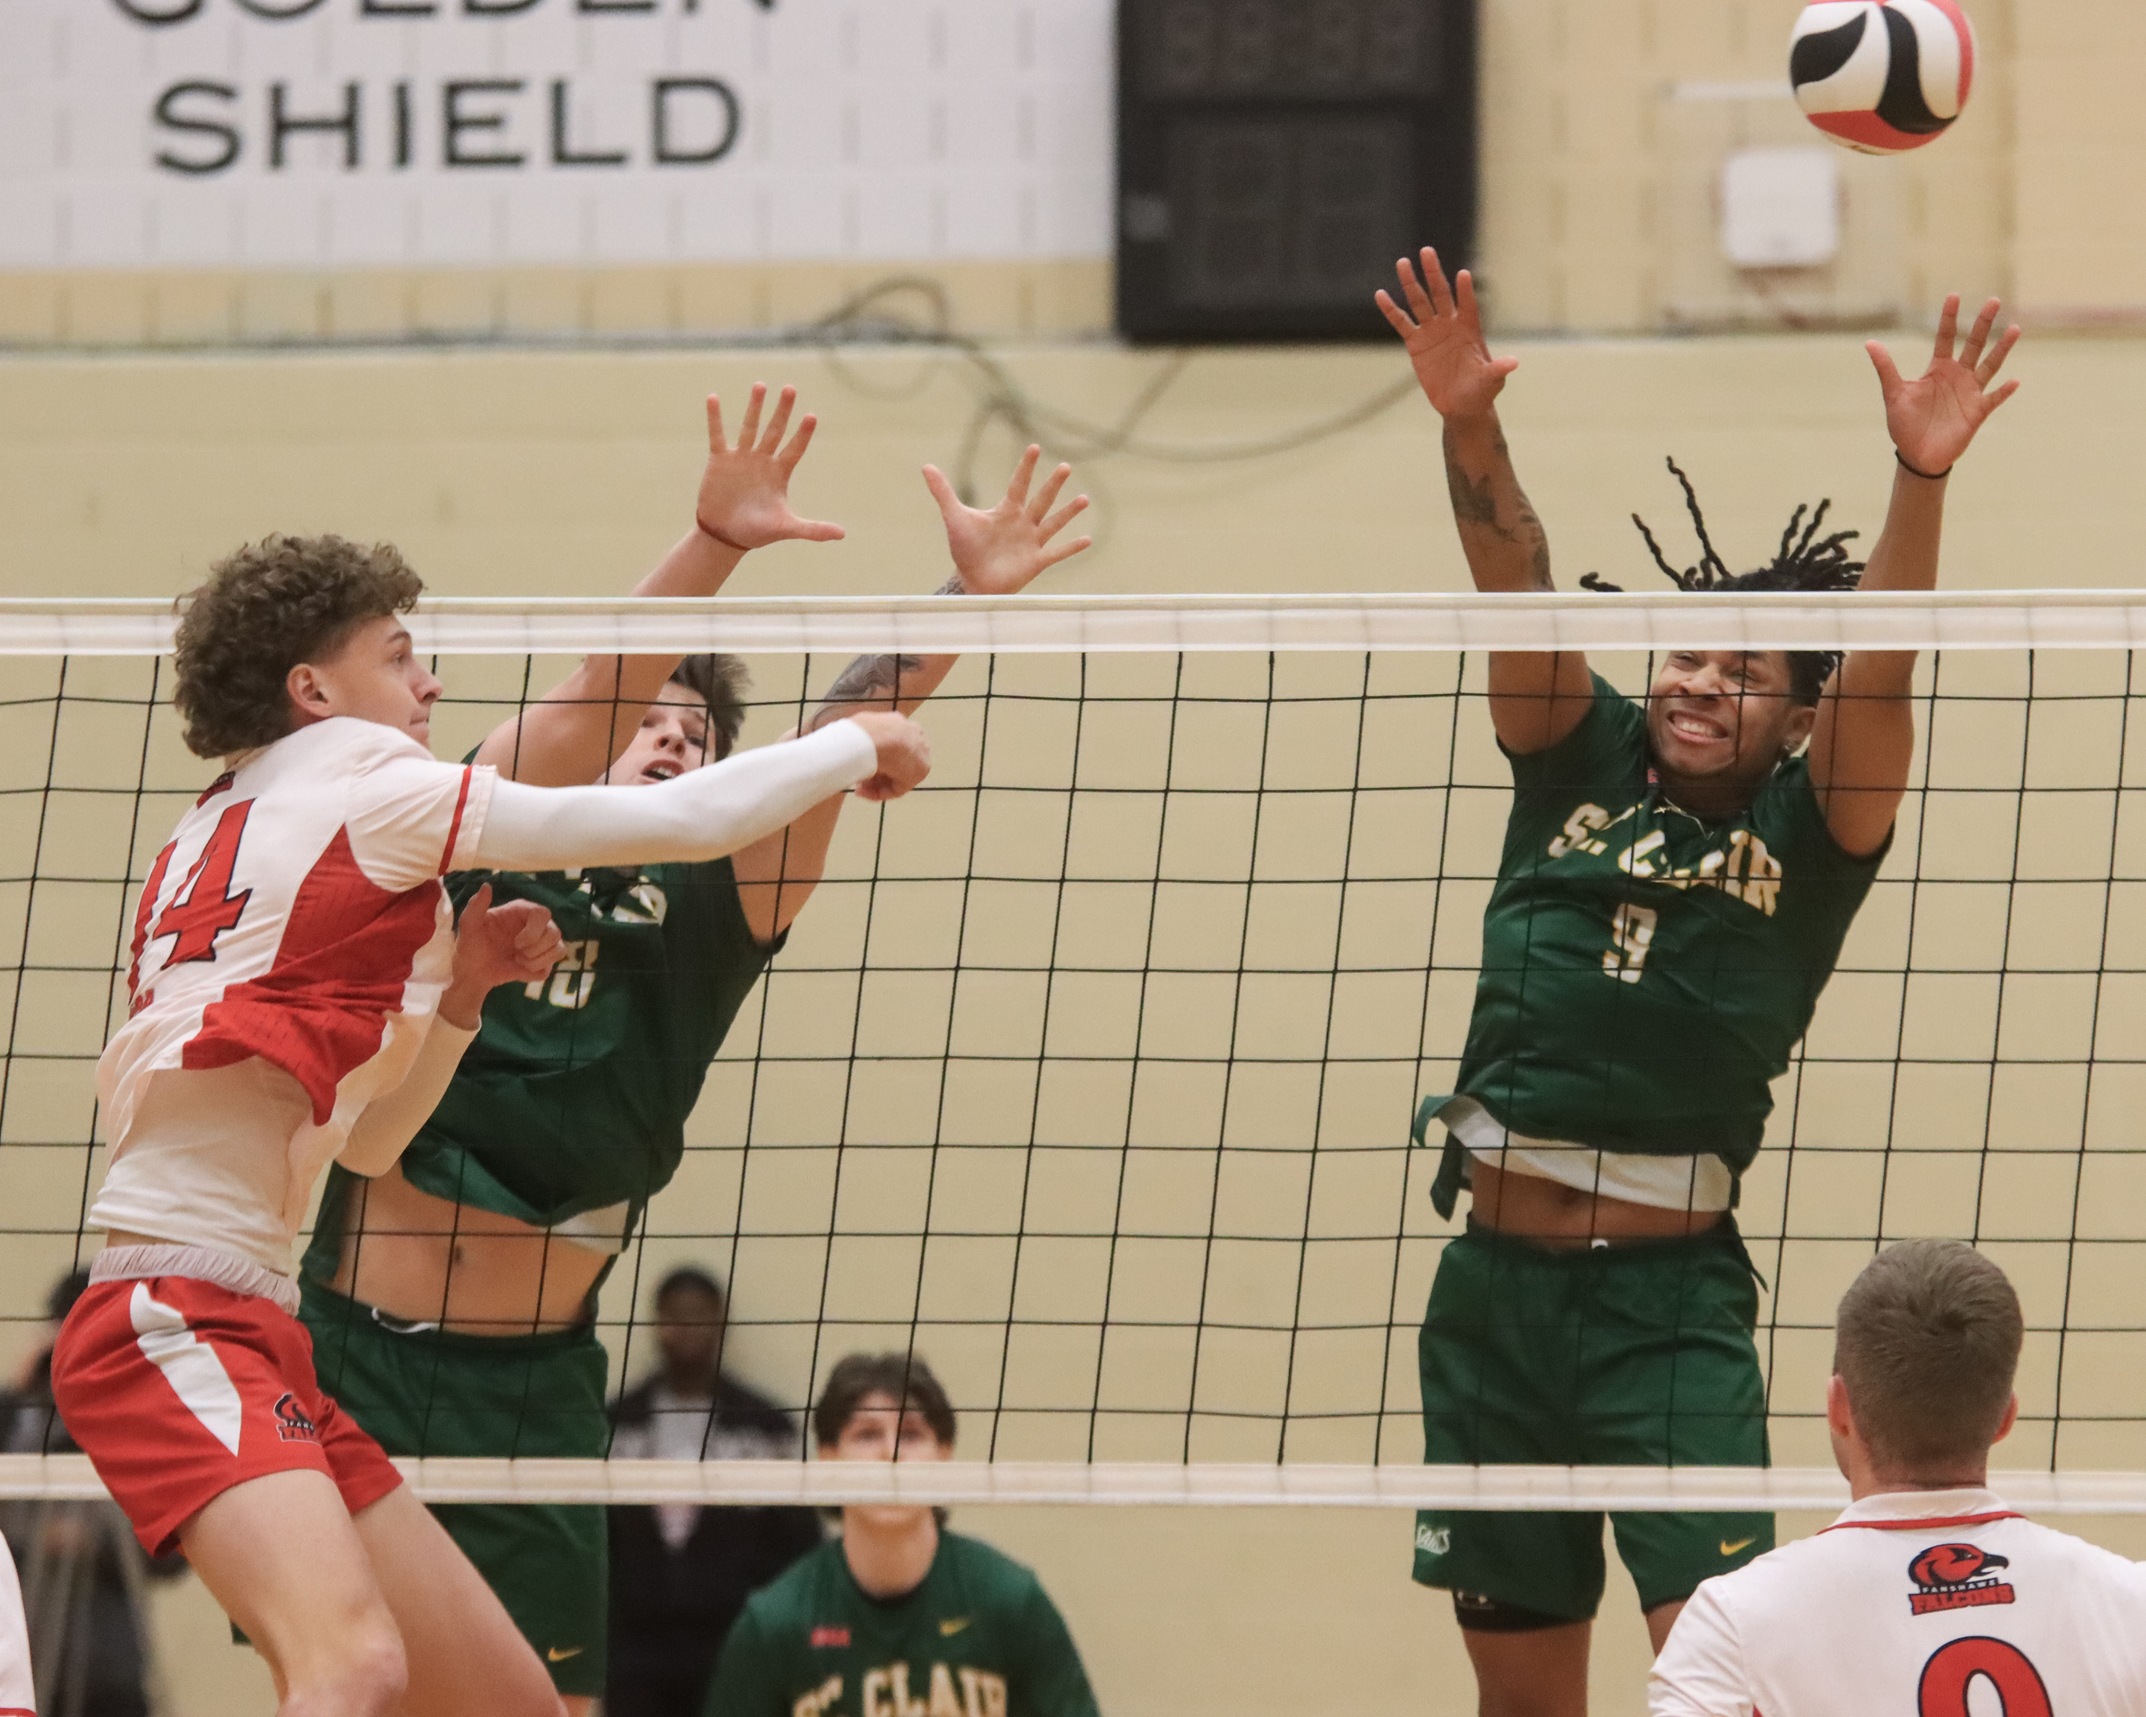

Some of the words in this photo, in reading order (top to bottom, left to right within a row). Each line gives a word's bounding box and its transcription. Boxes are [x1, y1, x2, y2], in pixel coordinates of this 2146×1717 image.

[152, 76, 741, 178] SHIELD
[127, 797, 258, 1006] 14
[1602, 903, 1658, 984] 9
[1909, 1583, 2016, 1616] FALCONS
[1921, 1578, 1998, 1594] FANSHAWE
